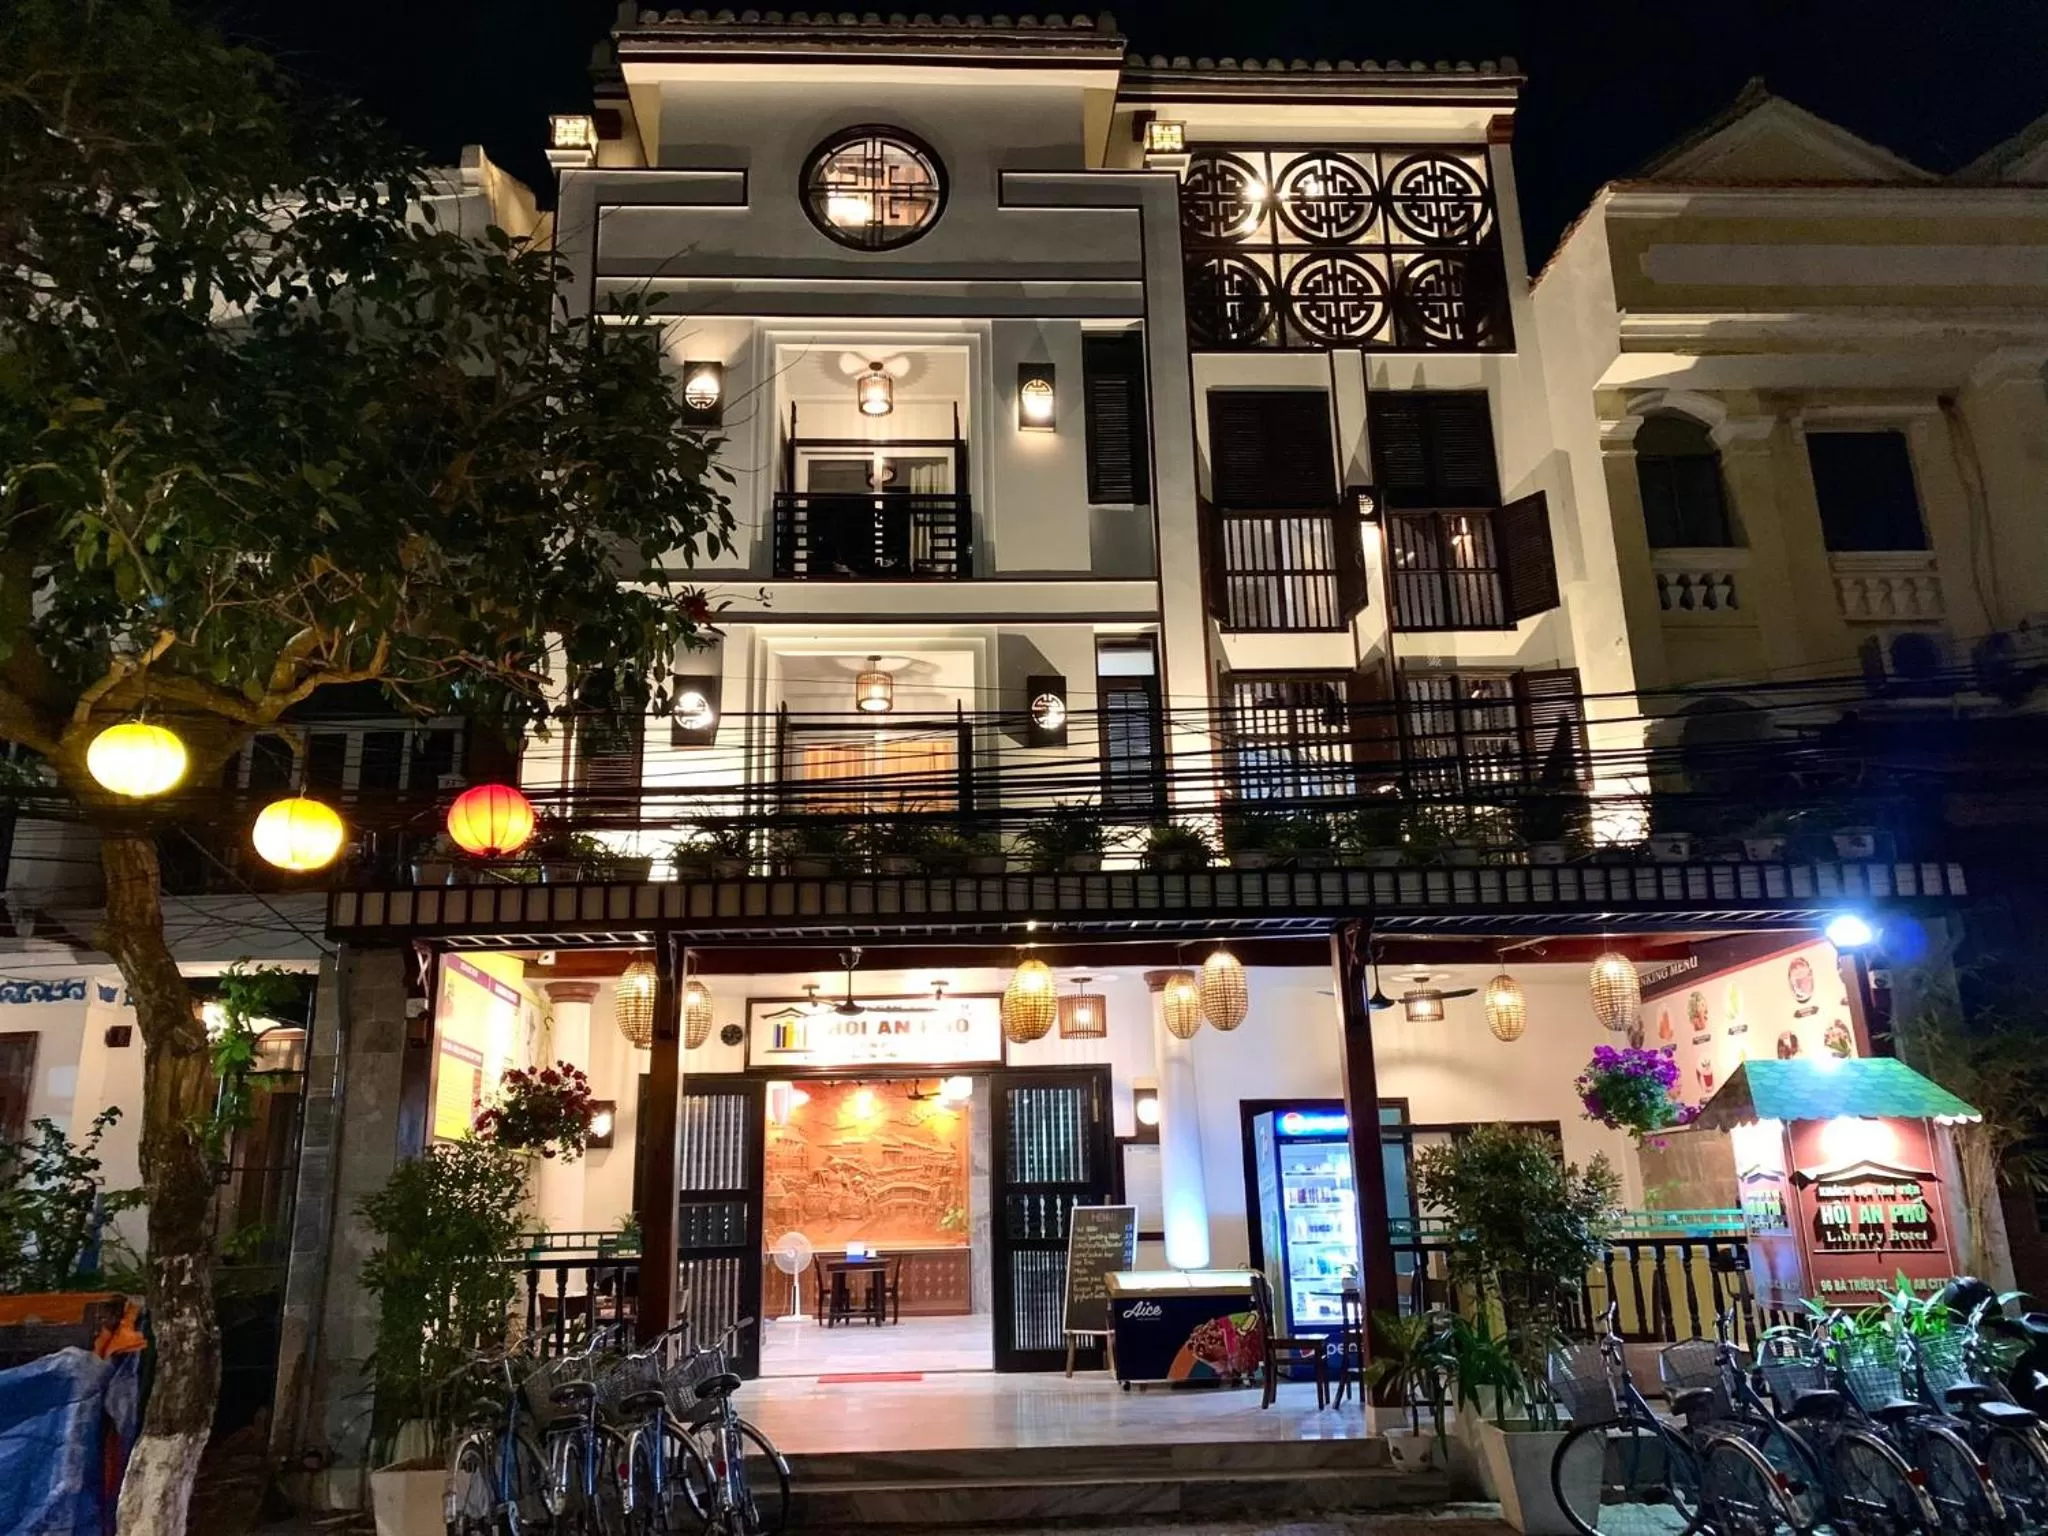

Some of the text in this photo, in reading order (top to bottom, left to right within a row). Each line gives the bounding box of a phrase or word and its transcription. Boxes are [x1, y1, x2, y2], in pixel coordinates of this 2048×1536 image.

[1670, 955, 1698, 977] MENU
[877, 1019, 911, 1035] AN
[1859, 1203, 1883, 1224] AN
[1889, 1196, 1928, 1224] PHỐ
[1827, 1228, 1929, 1244] Library Hotel
[1122, 1300, 1163, 1319] Aice
